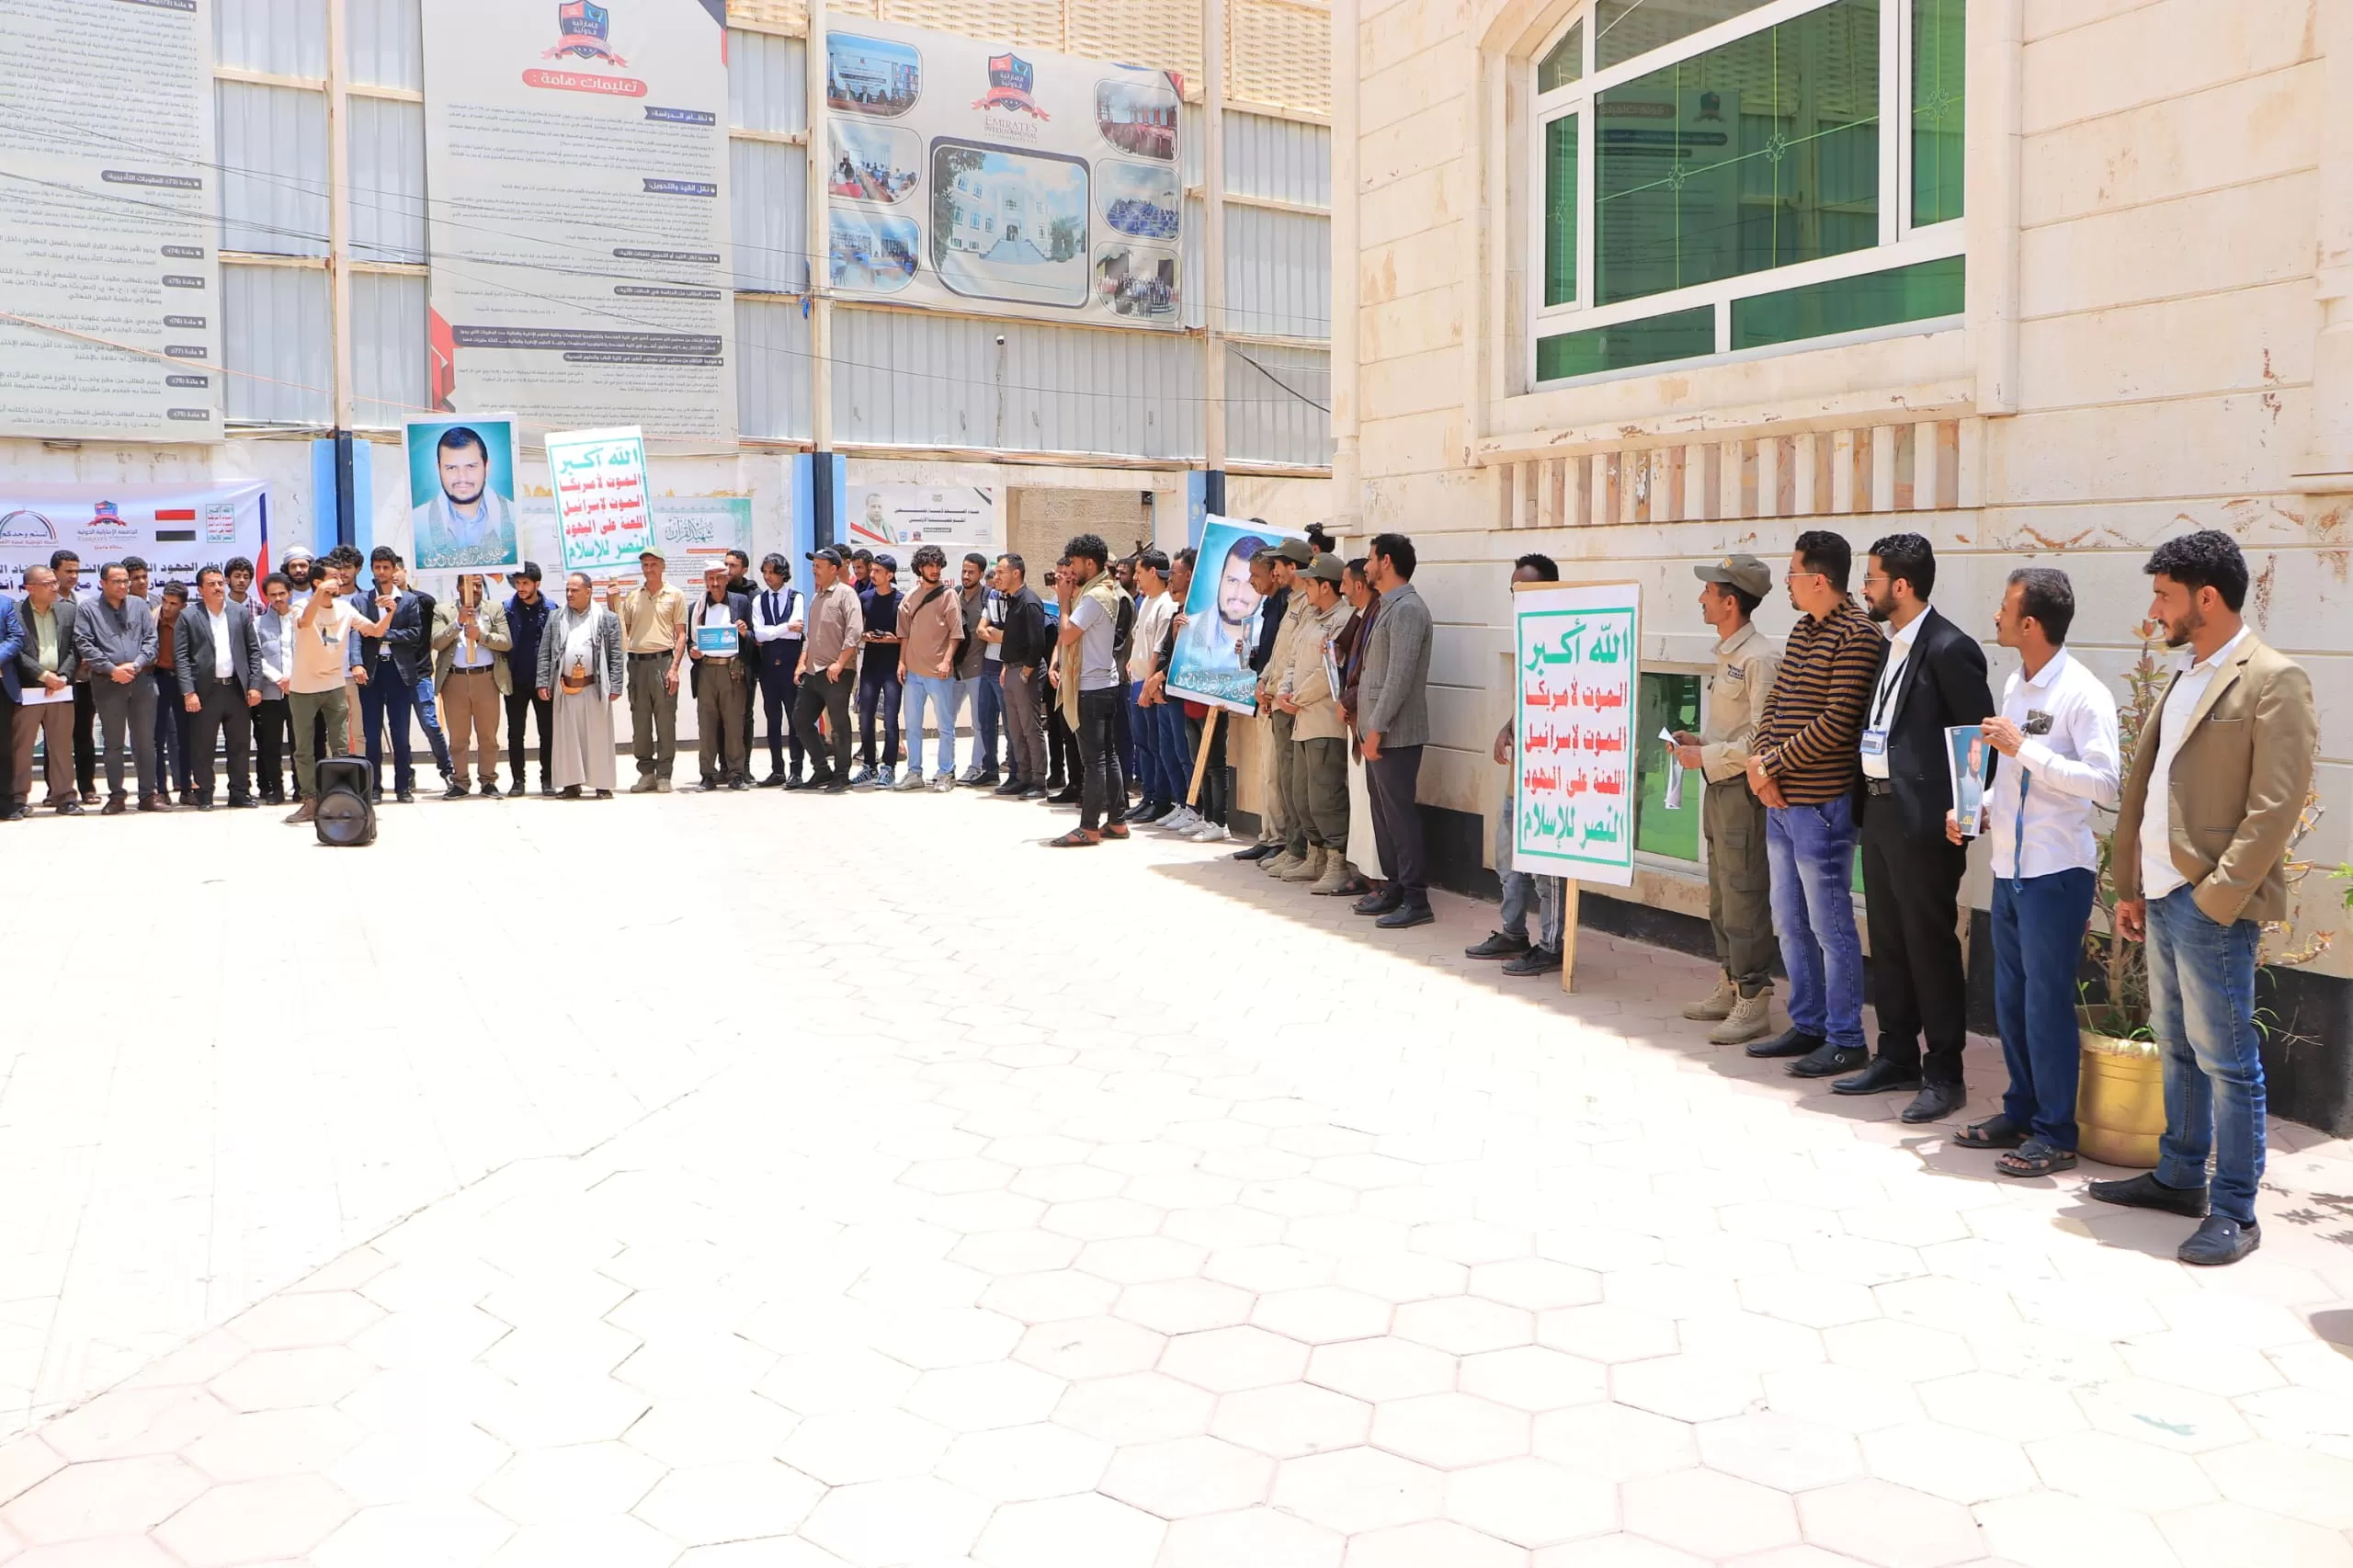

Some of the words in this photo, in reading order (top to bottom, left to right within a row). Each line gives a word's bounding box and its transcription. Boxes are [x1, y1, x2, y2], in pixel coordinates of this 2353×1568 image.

[540, 73, 576, 86] هامة
[580, 77, 638, 94] تعليمات
[985, 116, 1037, 133] EMIRATES
[558, 446, 603, 476] أكبر
[608, 446, 638, 466] الله
[607, 473, 641, 490] الموت
[609, 495, 644, 512] الموت
[566, 519, 596, 537] اليهود
[600, 518, 616, 535] على
[620, 515, 647, 530] اللعنة
[616, 534, 649, 559] النصر
[161, 562, 198, 574] الجهود
[1525, 618, 1587, 677] أكبر
[1588, 623, 1628, 664] الله
[1525, 675, 1578, 712] لأمريكا
[1582, 680, 1627, 713] الموت
[1583, 725, 1627, 756] الموت
[1524, 766, 1561, 795] اليهود
[1566, 767, 1587, 798] على
[1593, 766, 1625, 795] اللعنة
[1579, 803, 1624, 850] النصر
